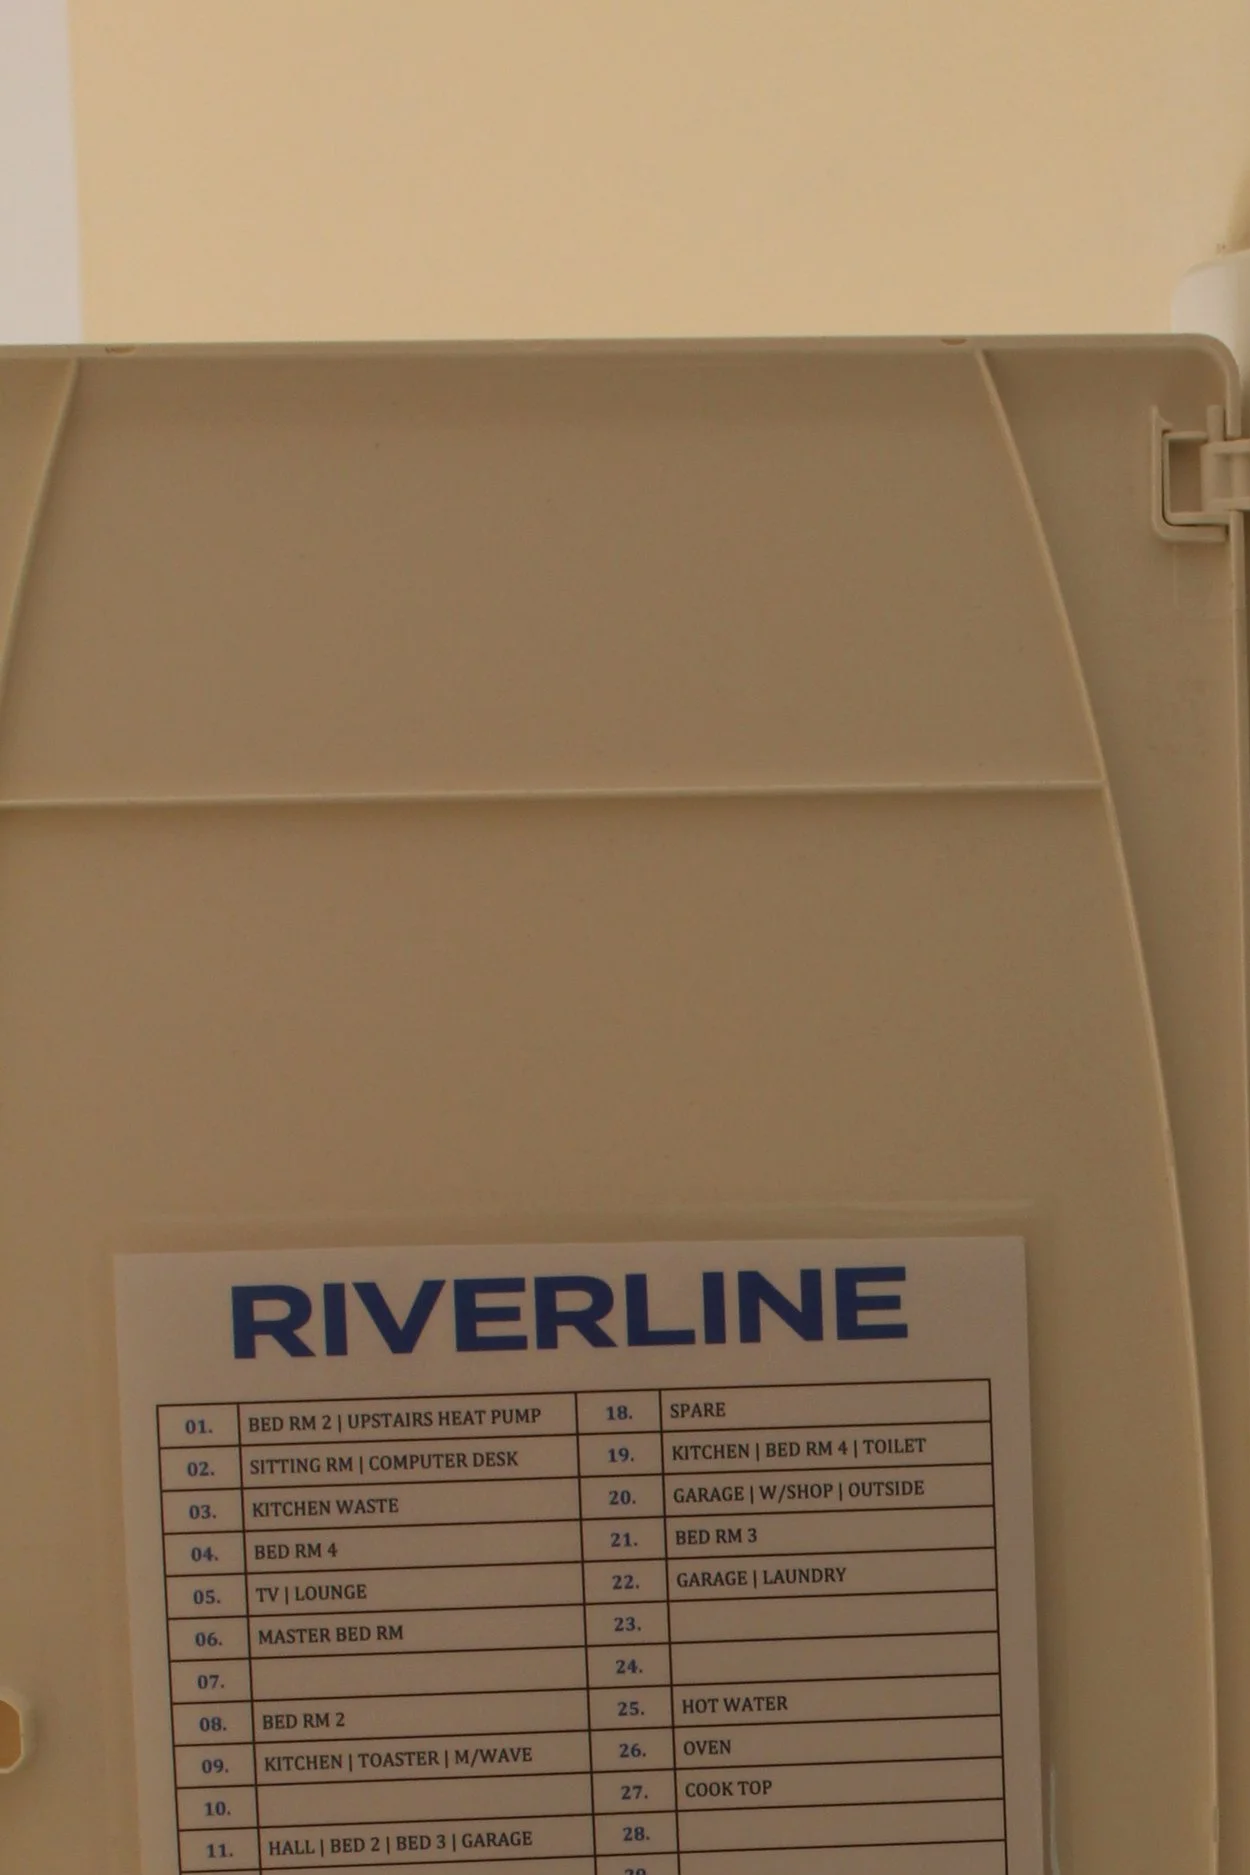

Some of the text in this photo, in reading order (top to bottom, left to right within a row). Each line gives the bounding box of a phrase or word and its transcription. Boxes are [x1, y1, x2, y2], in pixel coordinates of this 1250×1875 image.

[231, 1265, 909, 1360] RIVERLINE
[606, 1405, 632, 1421] 18.
[670, 1402, 726, 1419] SPARE
[185, 1419, 213, 1435] 01.
[248, 1408, 541, 1432] BED RM 2 UPSTAIRS HEAT PUMP
[608, 1447, 634, 1463] 19.
[672, 1437, 927, 1461] KITCHEN BED RM 4 TOILET
[187, 1461, 215, 1477] 02.
[250, 1451, 519, 1475] SITTING RM COMPUTER DESK
[609, 1490, 636, 1505] 20.
[673, 1480, 924, 1504] GARAGE W/SHOP OUTSIDE
[189, 1504, 217, 1520] 03.
[252, 1497, 399, 1518] KITCHEN WASTE
[610, 1532, 638, 1547] 21.
[675, 1528, 757, 1546] BED RM 3
[191, 1546, 219, 1562] 04.
[254, 1542, 338, 1560] BED RM 4
[612, 1574, 639, 1590] 22.
[676, 1567, 847, 1588] GARAGE LAUNDRY
[193, 1589, 221, 1605] 05.
[255, 1584, 367, 1603] TV LOUNGE
[195, 1632, 223, 1647] 06.
[258, 1624, 404, 1645] MASTER BED RM
[682, 1696, 788, 1714] HOT WATER
[262, 1712, 345, 1730] BED RM 2
[683, 1739, 731, 1756] OVEN
[264, 1747, 532, 1772] KITCHEN TOASTER M/WAVE
[685, 1780, 772, 1798] COOK TOP
[268, 1831, 533, 1856] HALL BED 2 BED 3 GARAGE
